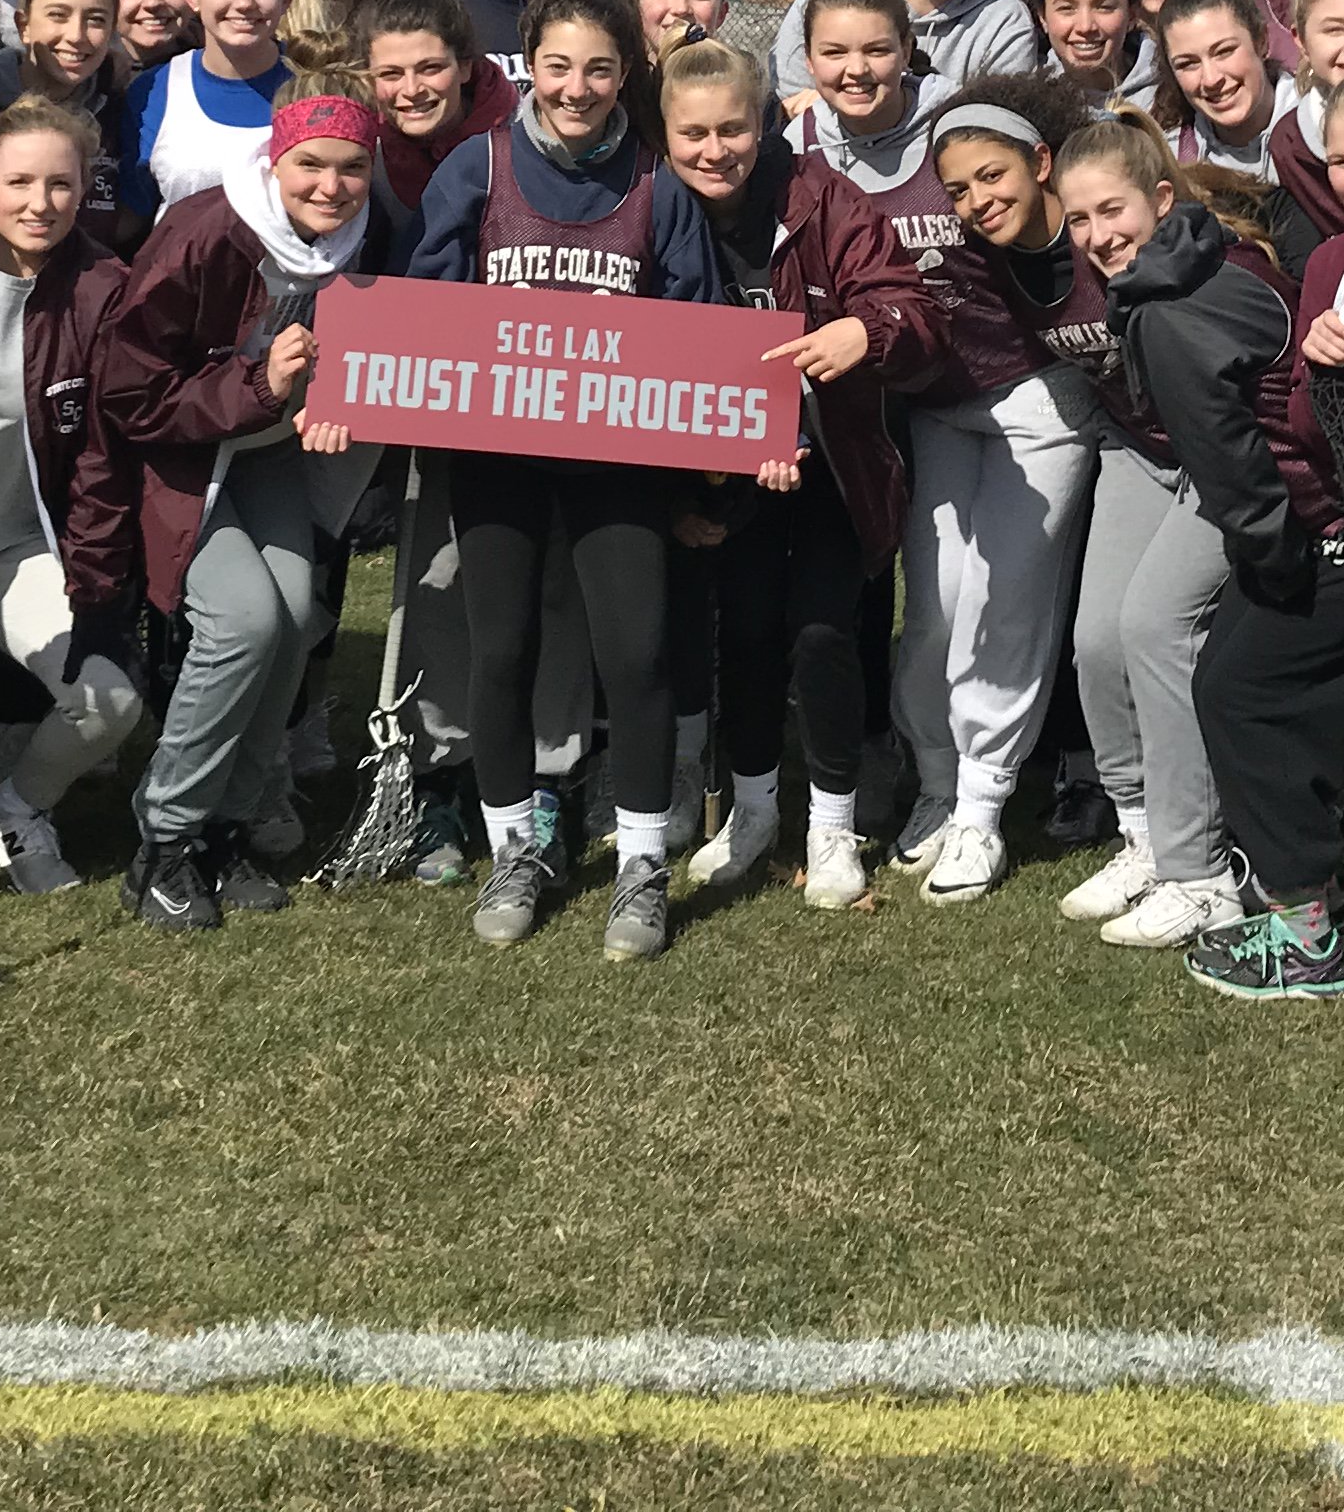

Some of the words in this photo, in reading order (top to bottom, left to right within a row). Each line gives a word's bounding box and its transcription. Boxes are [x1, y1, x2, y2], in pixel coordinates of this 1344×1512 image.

[891, 214, 965, 249] OLLEGE
[487, 245, 552, 286] STATE
[554, 246, 641, 294] COLLEGE
[496, 320, 554, 358] SCG
[563, 326, 623, 364] LAX
[343, 351, 479, 414] TRUST
[489, 364, 568, 421] THE
[576, 372, 768, 441] PROCESS
